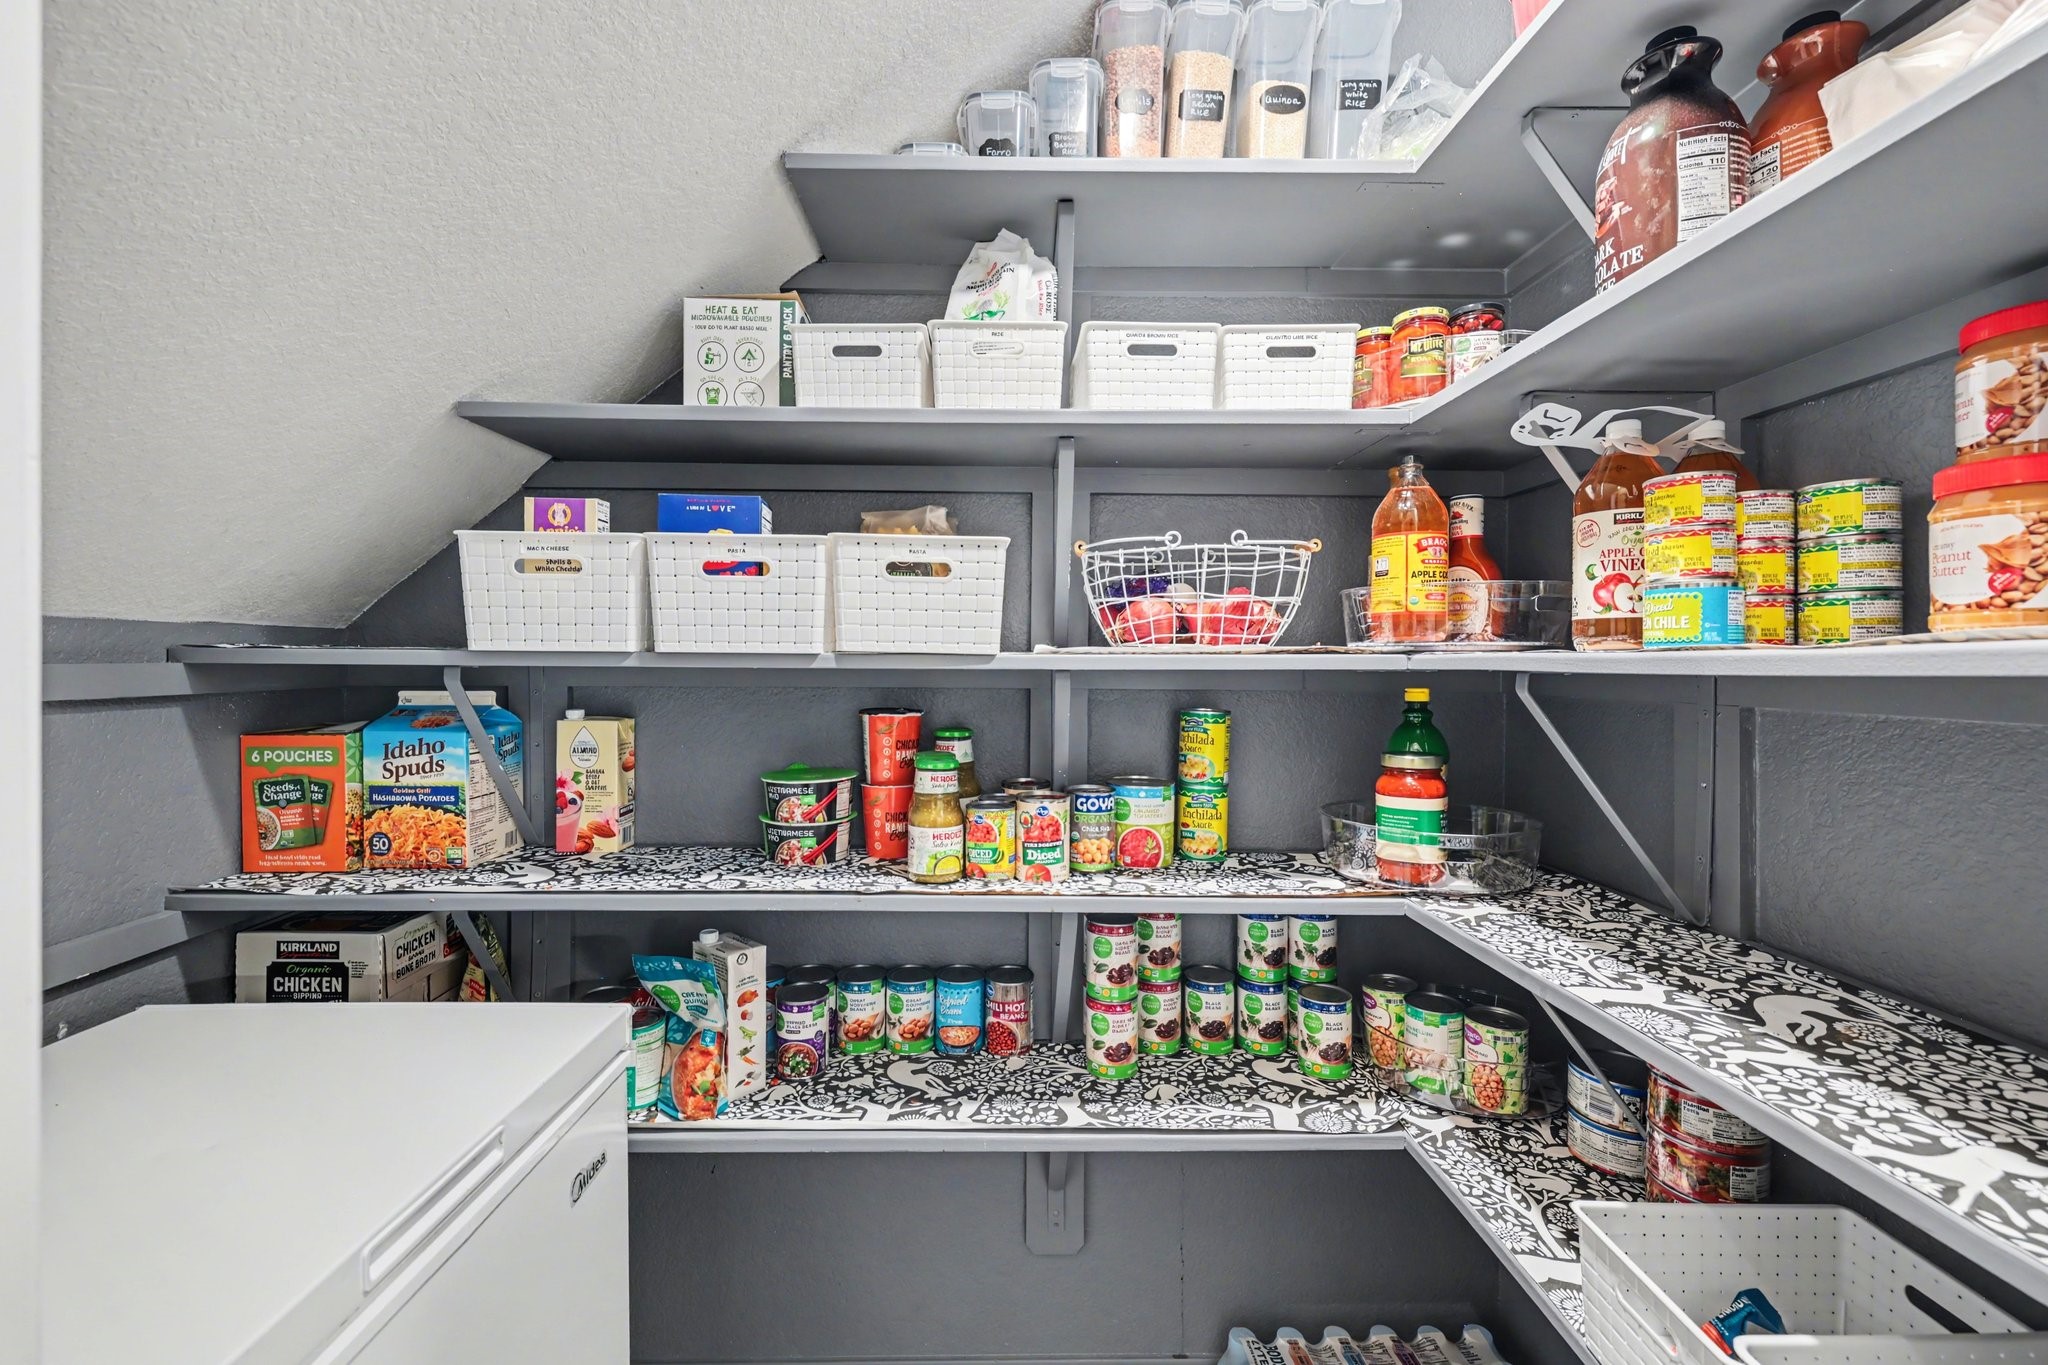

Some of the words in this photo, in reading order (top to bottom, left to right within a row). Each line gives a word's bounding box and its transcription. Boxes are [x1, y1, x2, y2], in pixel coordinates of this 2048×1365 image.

[986, 148, 1012, 157] Farro
[1709, 156, 1727, 165] 110
[1760, 165, 1779, 179] 120
[705, 305, 728, 315] HEAT
[731, 306, 738, 314] &
[742, 306, 758, 315] EAT
[1599, 547, 1636, 559] APPLE
[1411, 570, 1437, 579] APPLE
[1654, 615, 1691, 629] CHILE
[382, 737, 445, 761] Idaho
[251, 751, 260, 762] 6
[263, 750, 334, 763] POUCHES
[382, 755, 446, 783] Spuds
[263, 782, 293, 794] Seeds
[767, 785, 815, 795] VIETNAMESE
[262, 788, 303, 803] Change
[418, 793, 456, 802] POTATOES
[1076, 796, 1115, 812] GOYA
[1182, 807, 1223, 820] Enchilada
[767, 827, 815, 837] VIETNAMESE
[372, 838, 389, 850] 50
[1026, 848, 1062, 860] Diced
[280, 942, 338, 953] KIRKLAND
[396, 928, 437, 961] CHICKEN
[286, 963, 332, 975] Organic
[396, 962, 415, 981] BONE
[415, 948, 437, 970] BROTH
[273, 976, 343, 993] CHICKEN
[293, 992, 323, 1000] SIPPING
[1004, 1001, 1026, 1012] HOT
[1000, 1011, 1026, 1020] BEANS
